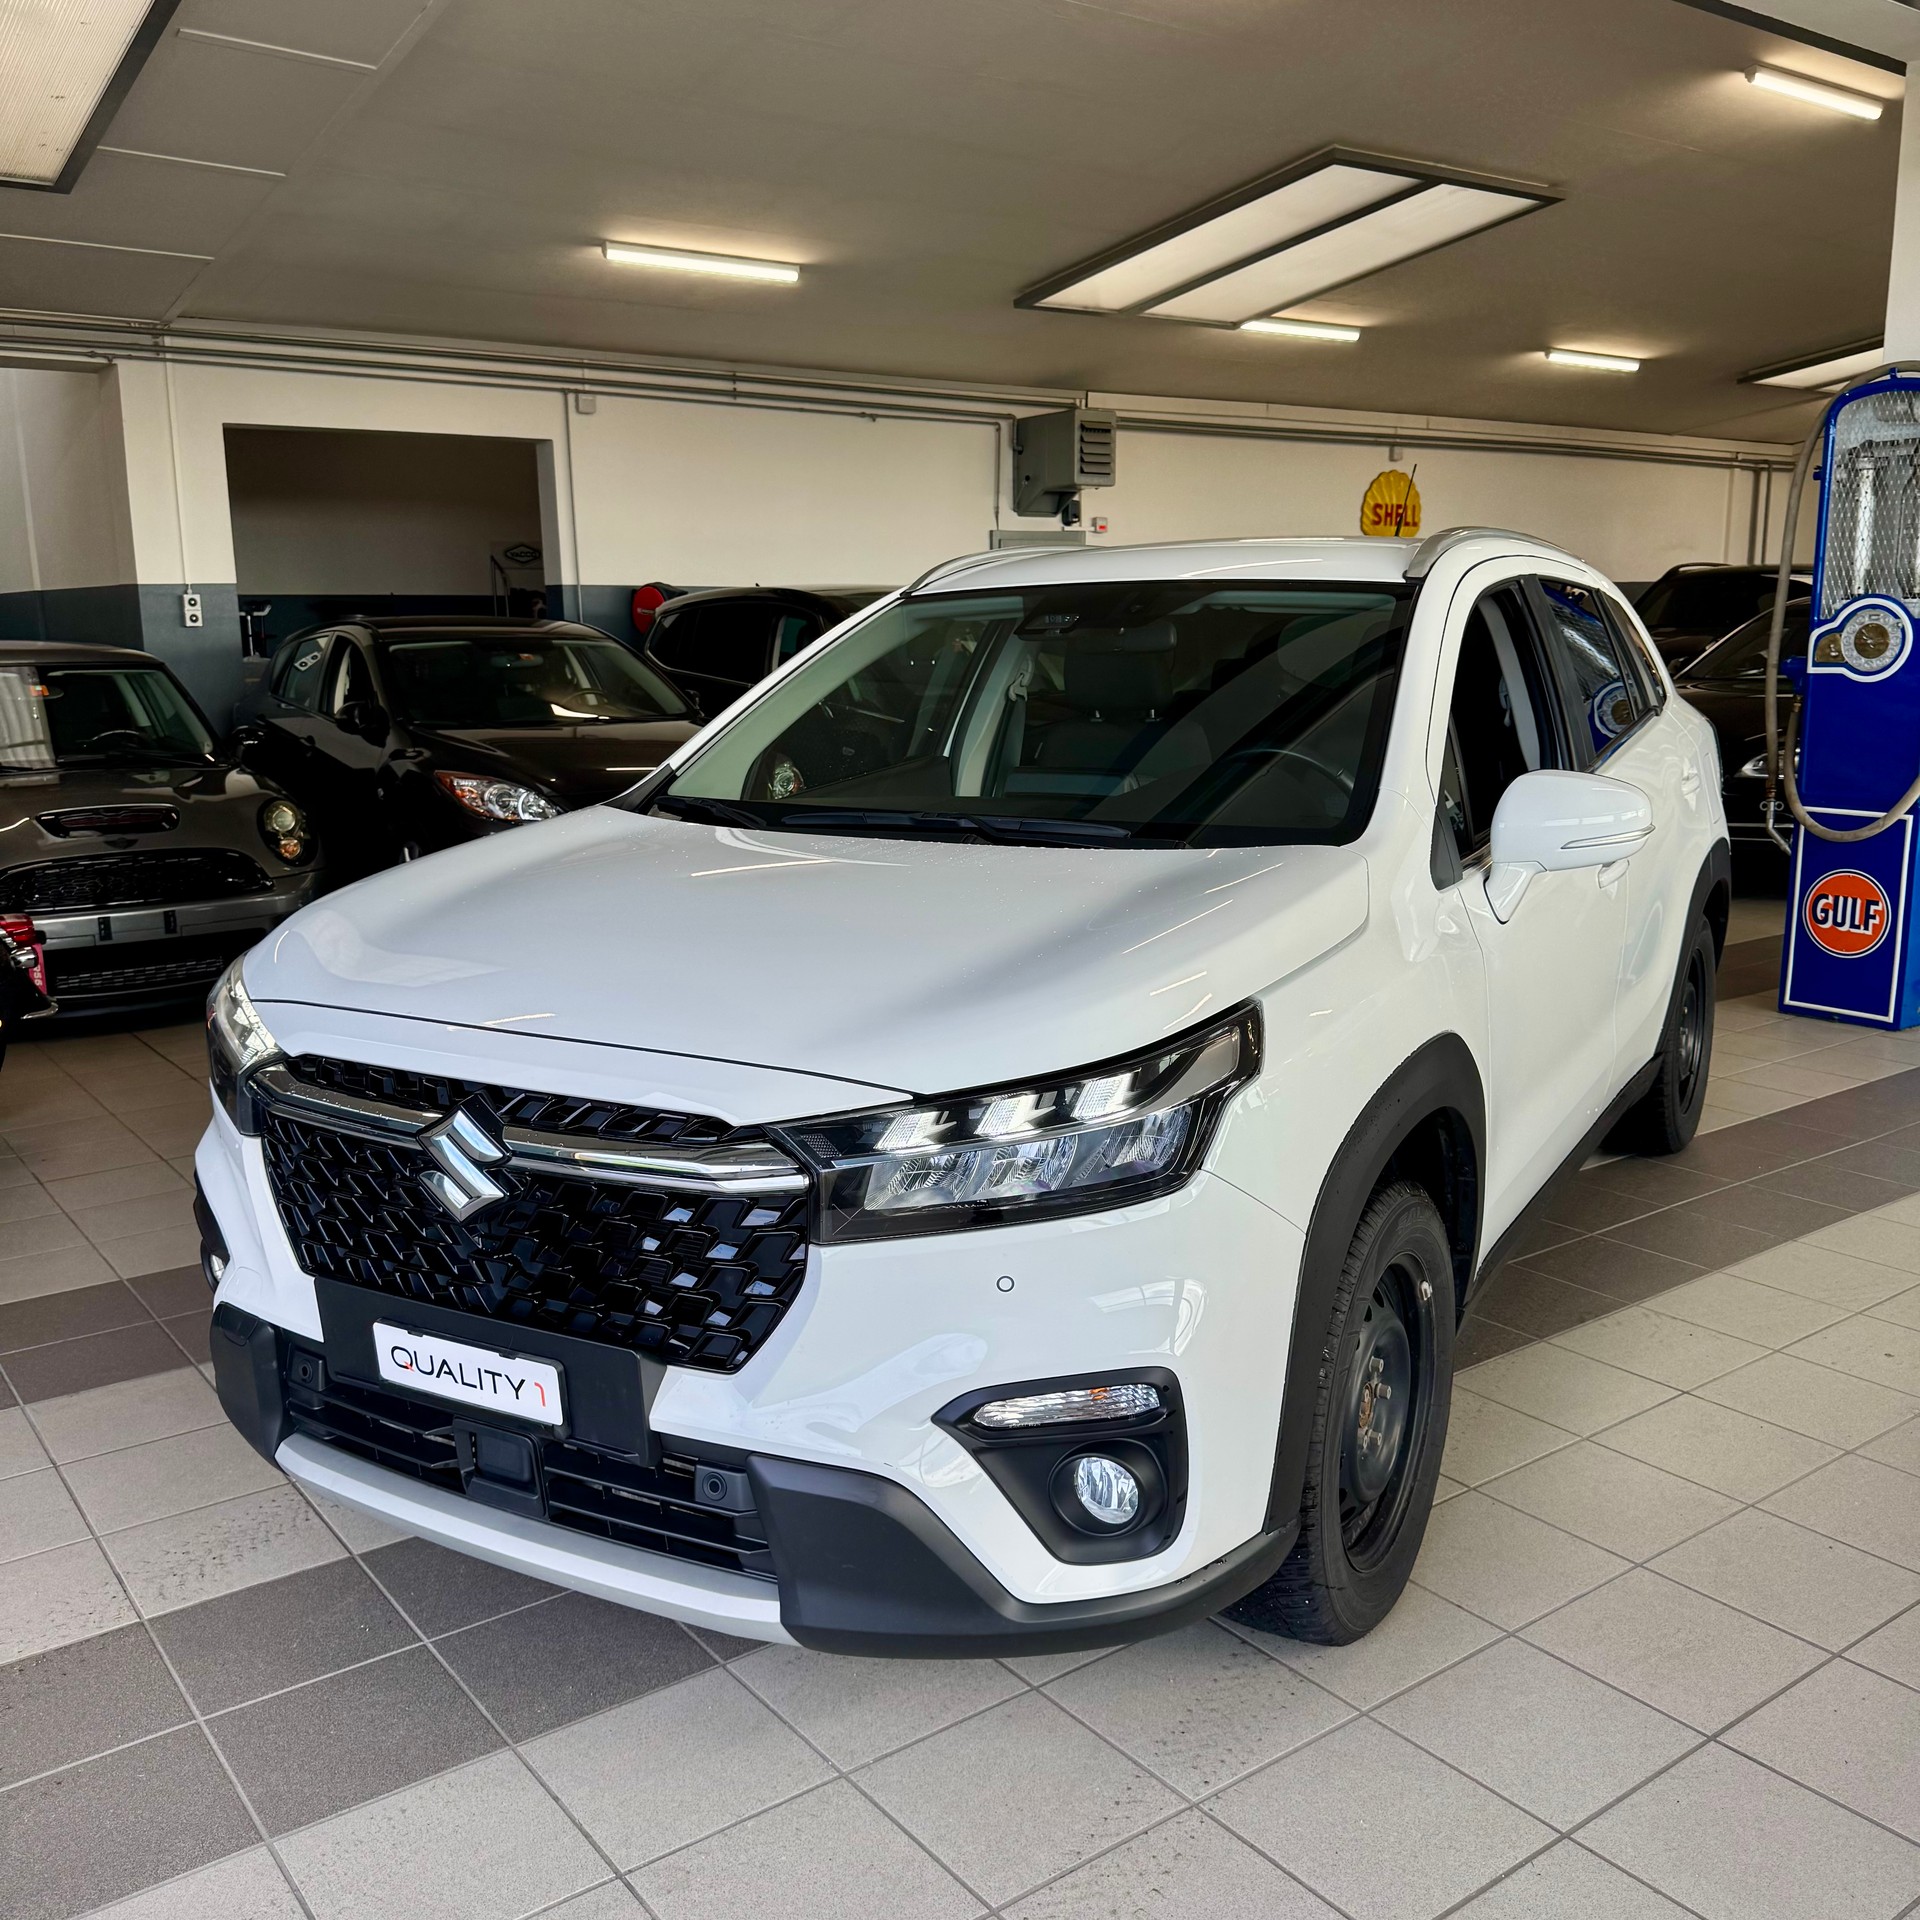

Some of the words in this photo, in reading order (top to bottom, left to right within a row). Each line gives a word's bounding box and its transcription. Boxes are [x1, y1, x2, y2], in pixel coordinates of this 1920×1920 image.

[1371, 503, 1419, 527] SHELL
[1812, 893, 1883, 935] GULF
[391, 1345, 526, 1400] QUALITY
[534, 1382, 546, 1407] 1
